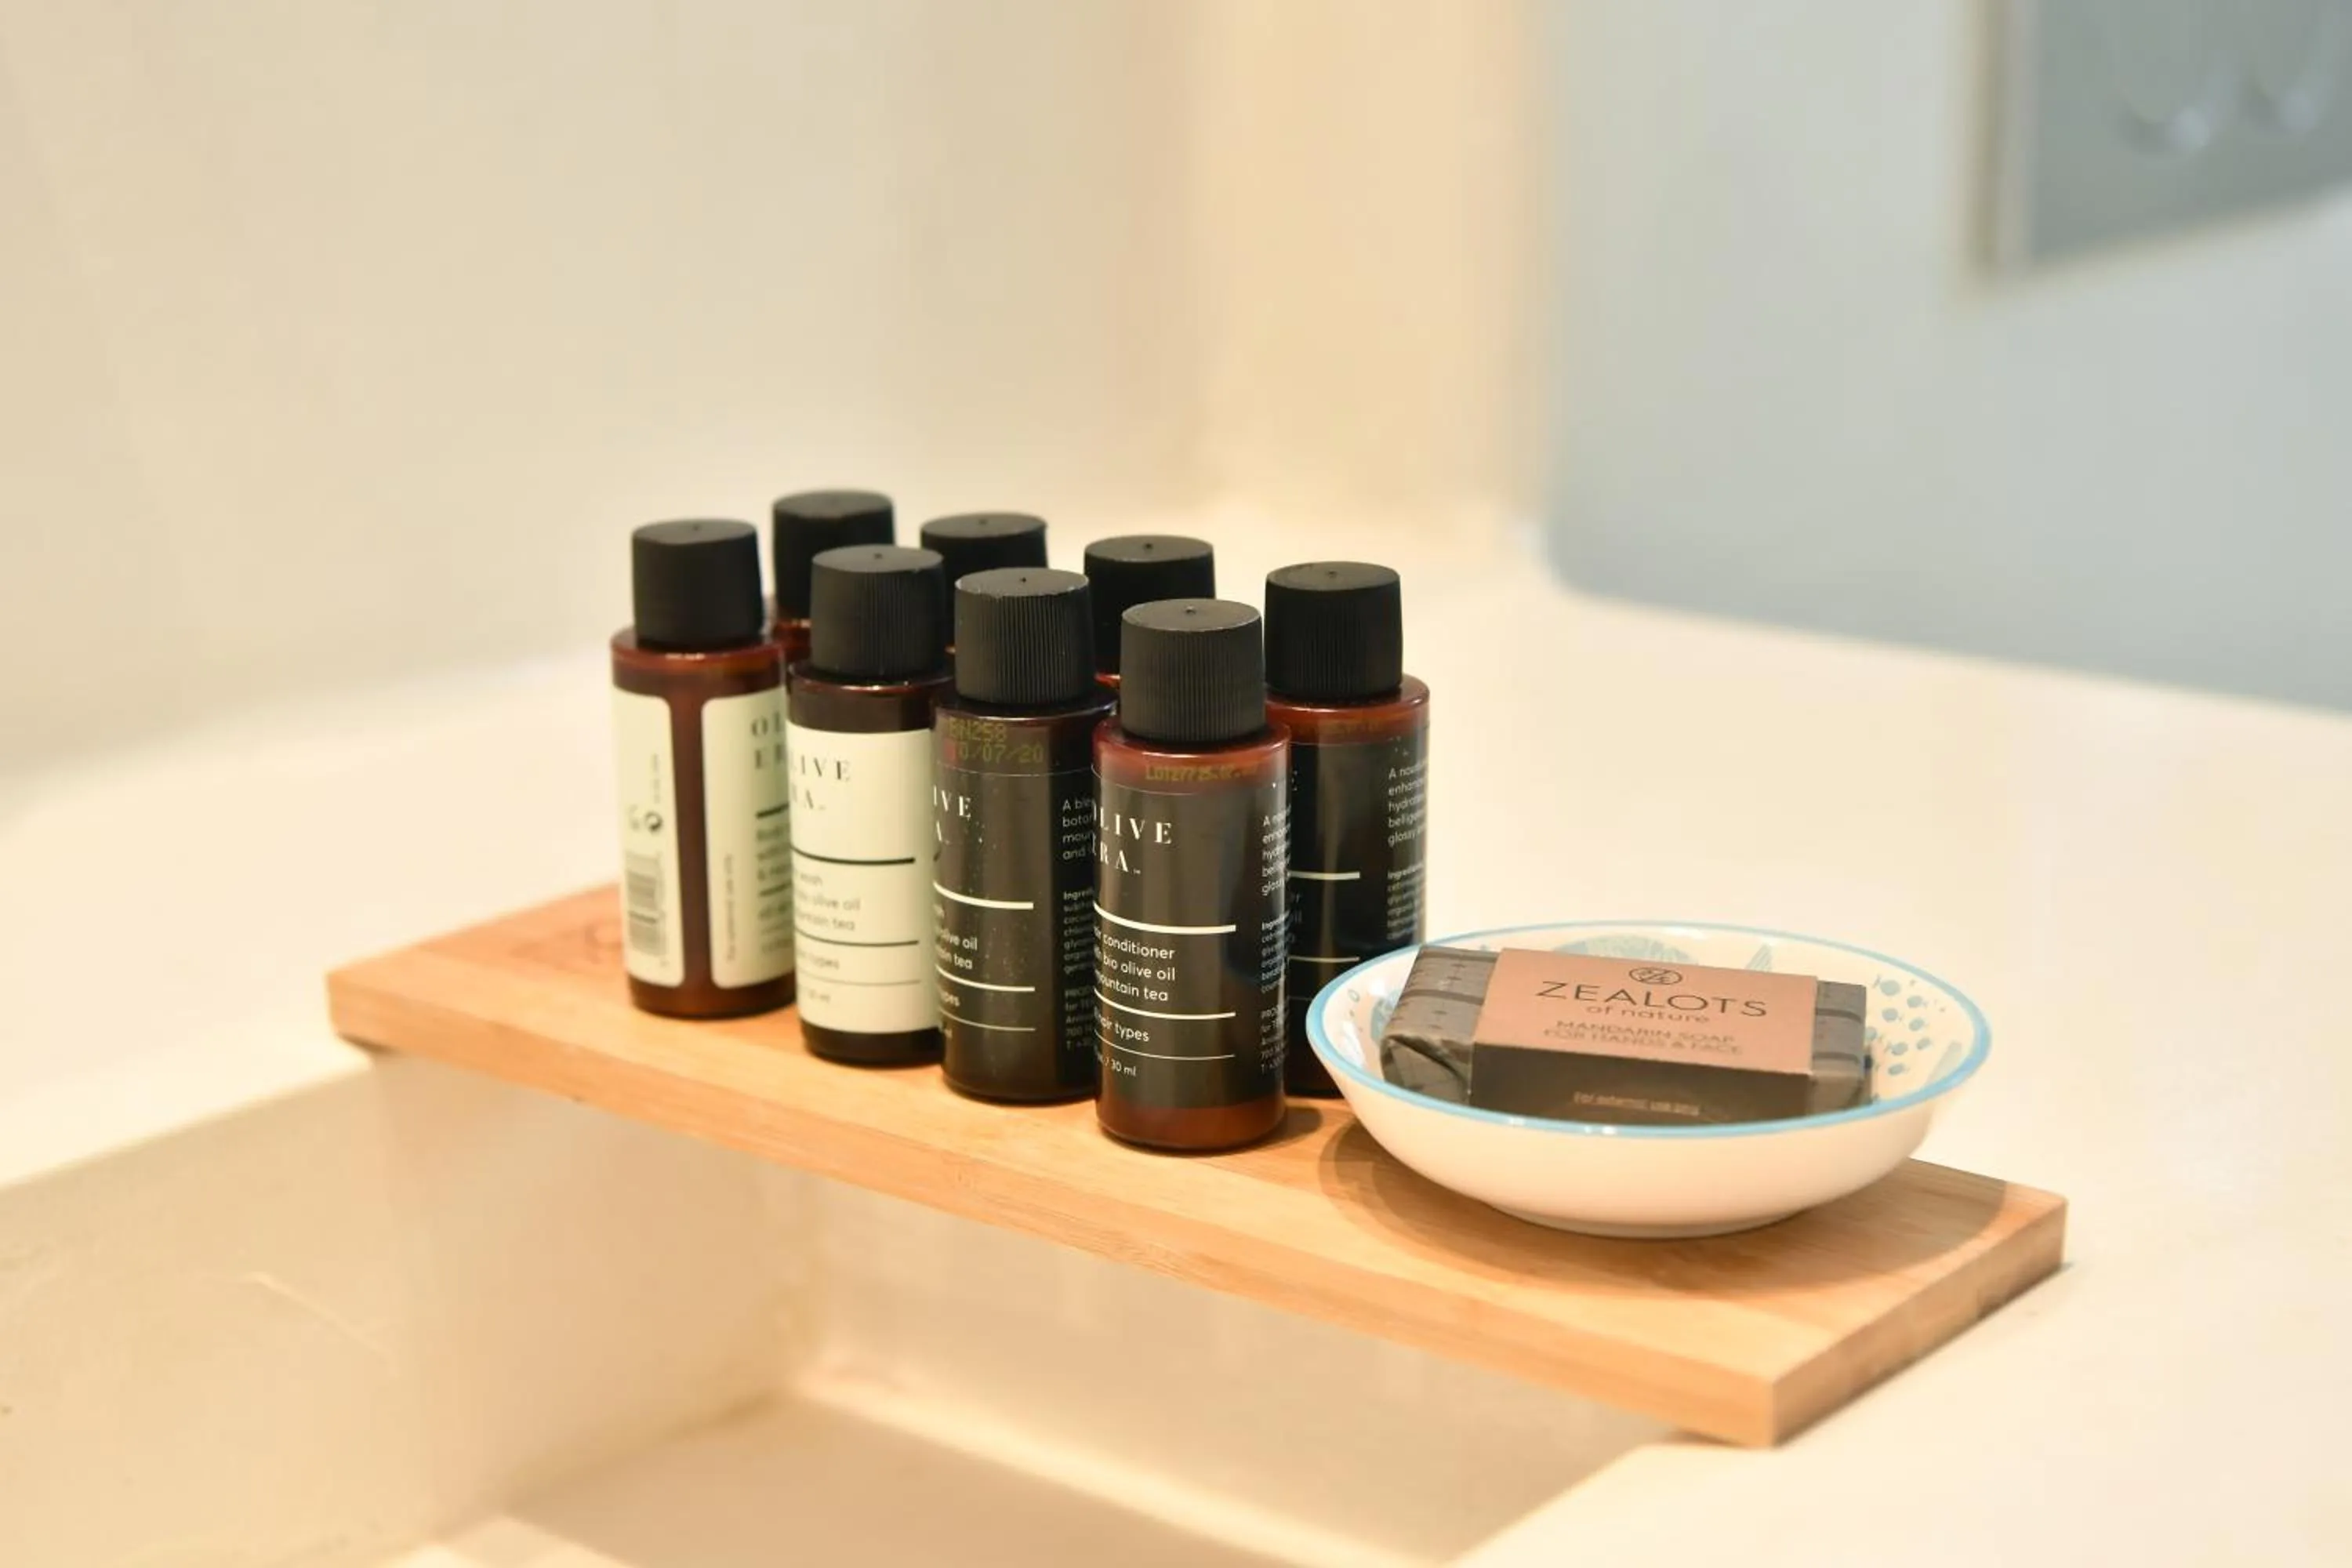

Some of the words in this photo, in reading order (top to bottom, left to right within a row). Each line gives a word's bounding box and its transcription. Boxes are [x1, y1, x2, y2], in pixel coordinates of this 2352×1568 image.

[1062, 846, 1086, 860] and
[962, 936, 978, 951] oil
[1103, 933, 1175, 960] conditioner
[953, 953, 973, 971] tea
[1103, 953, 1117, 970] bio
[1120, 960, 1152, 978] olive
[1156, 966, 1175, 982] oil
[1144, 985, 1168, 1002] tea
[1535, 980, 1767, 1018] ZEALOTS
[1585, 1006, 1613, 1015] of
[1621, 1008, 1711, 1023] nature
[1115, 1021, 1150, 1043] types
[1123, 1065, 1137, 1077] ml
